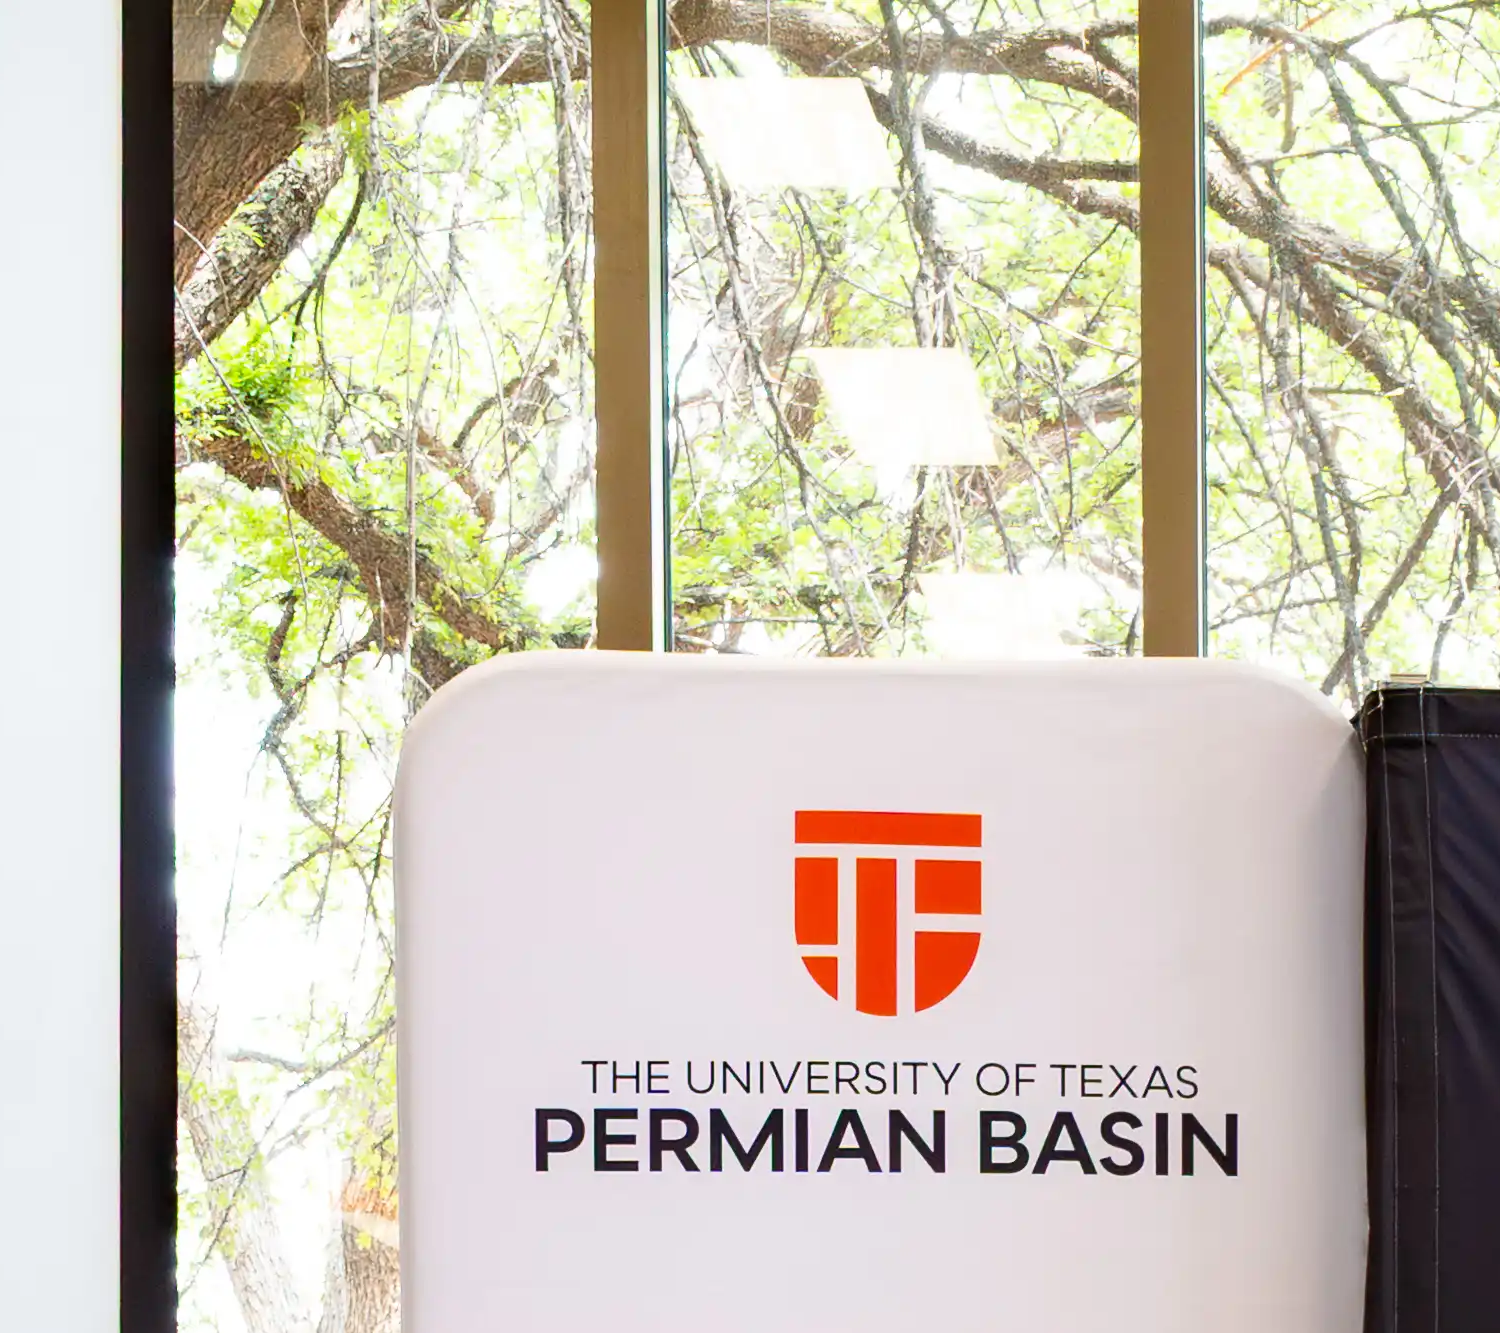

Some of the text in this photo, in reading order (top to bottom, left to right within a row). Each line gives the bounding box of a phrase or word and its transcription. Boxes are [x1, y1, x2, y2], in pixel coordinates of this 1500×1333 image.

[581, 1060, 1199, 1099] THE UNIVERSITY OF TEXAS
[534, 1107, 1239, 1177] PERMIAN BASIN
